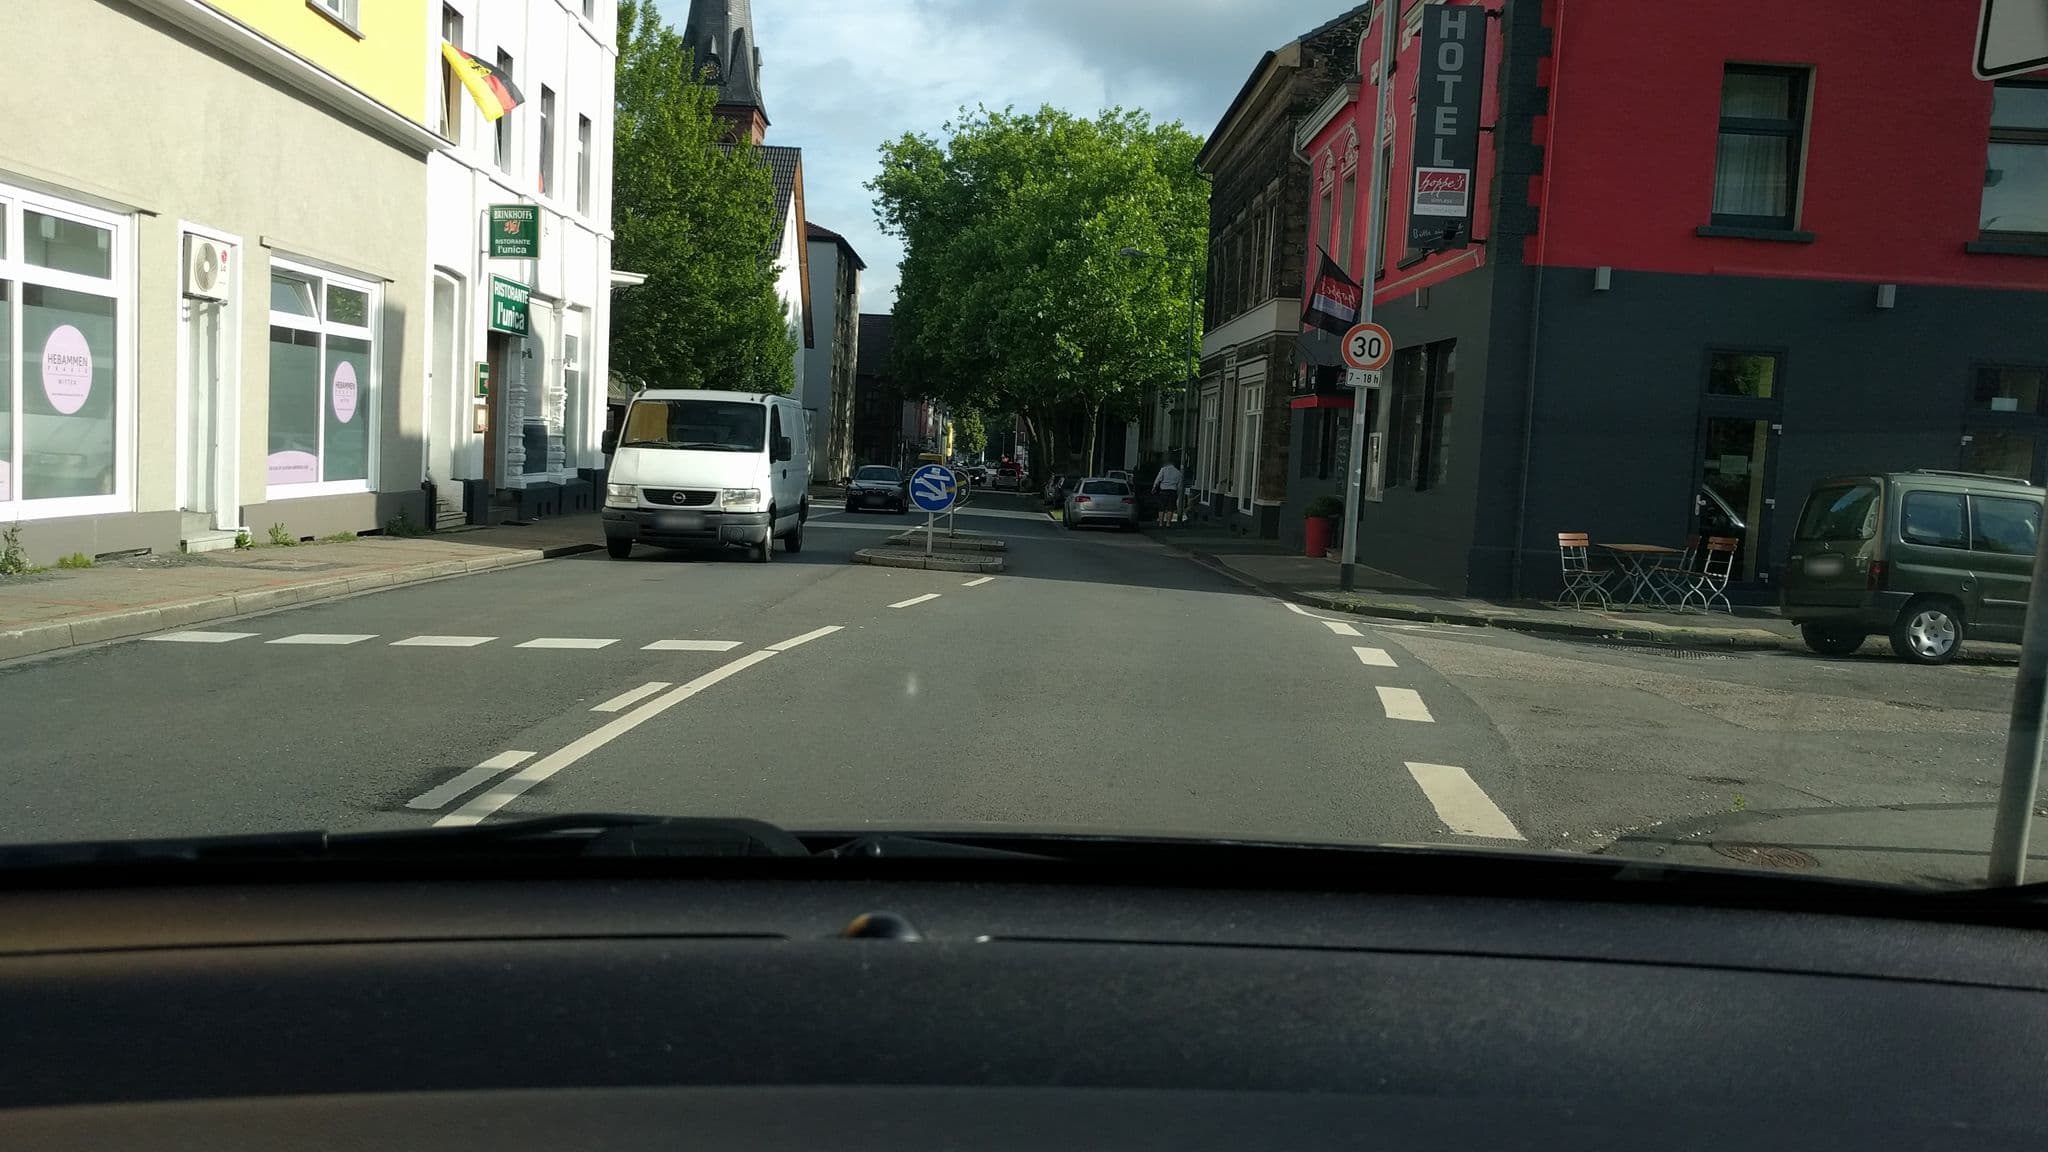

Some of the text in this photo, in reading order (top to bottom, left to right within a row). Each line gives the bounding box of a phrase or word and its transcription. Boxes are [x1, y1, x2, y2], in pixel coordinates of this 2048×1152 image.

[1433, 10, 1467, 167] HOTEL
[494, 280, 529, 304] RISTORANTE
[497, 301, 525, 330] l'unica
[1353, 336, 1381, 359] 30
[47, 353, 88, 367] HEBAMMEN
[1349, 372, 1355, 382] 7
[1363, 373, 1372, 384] 18
[1373, 375, 1379, 384] h
